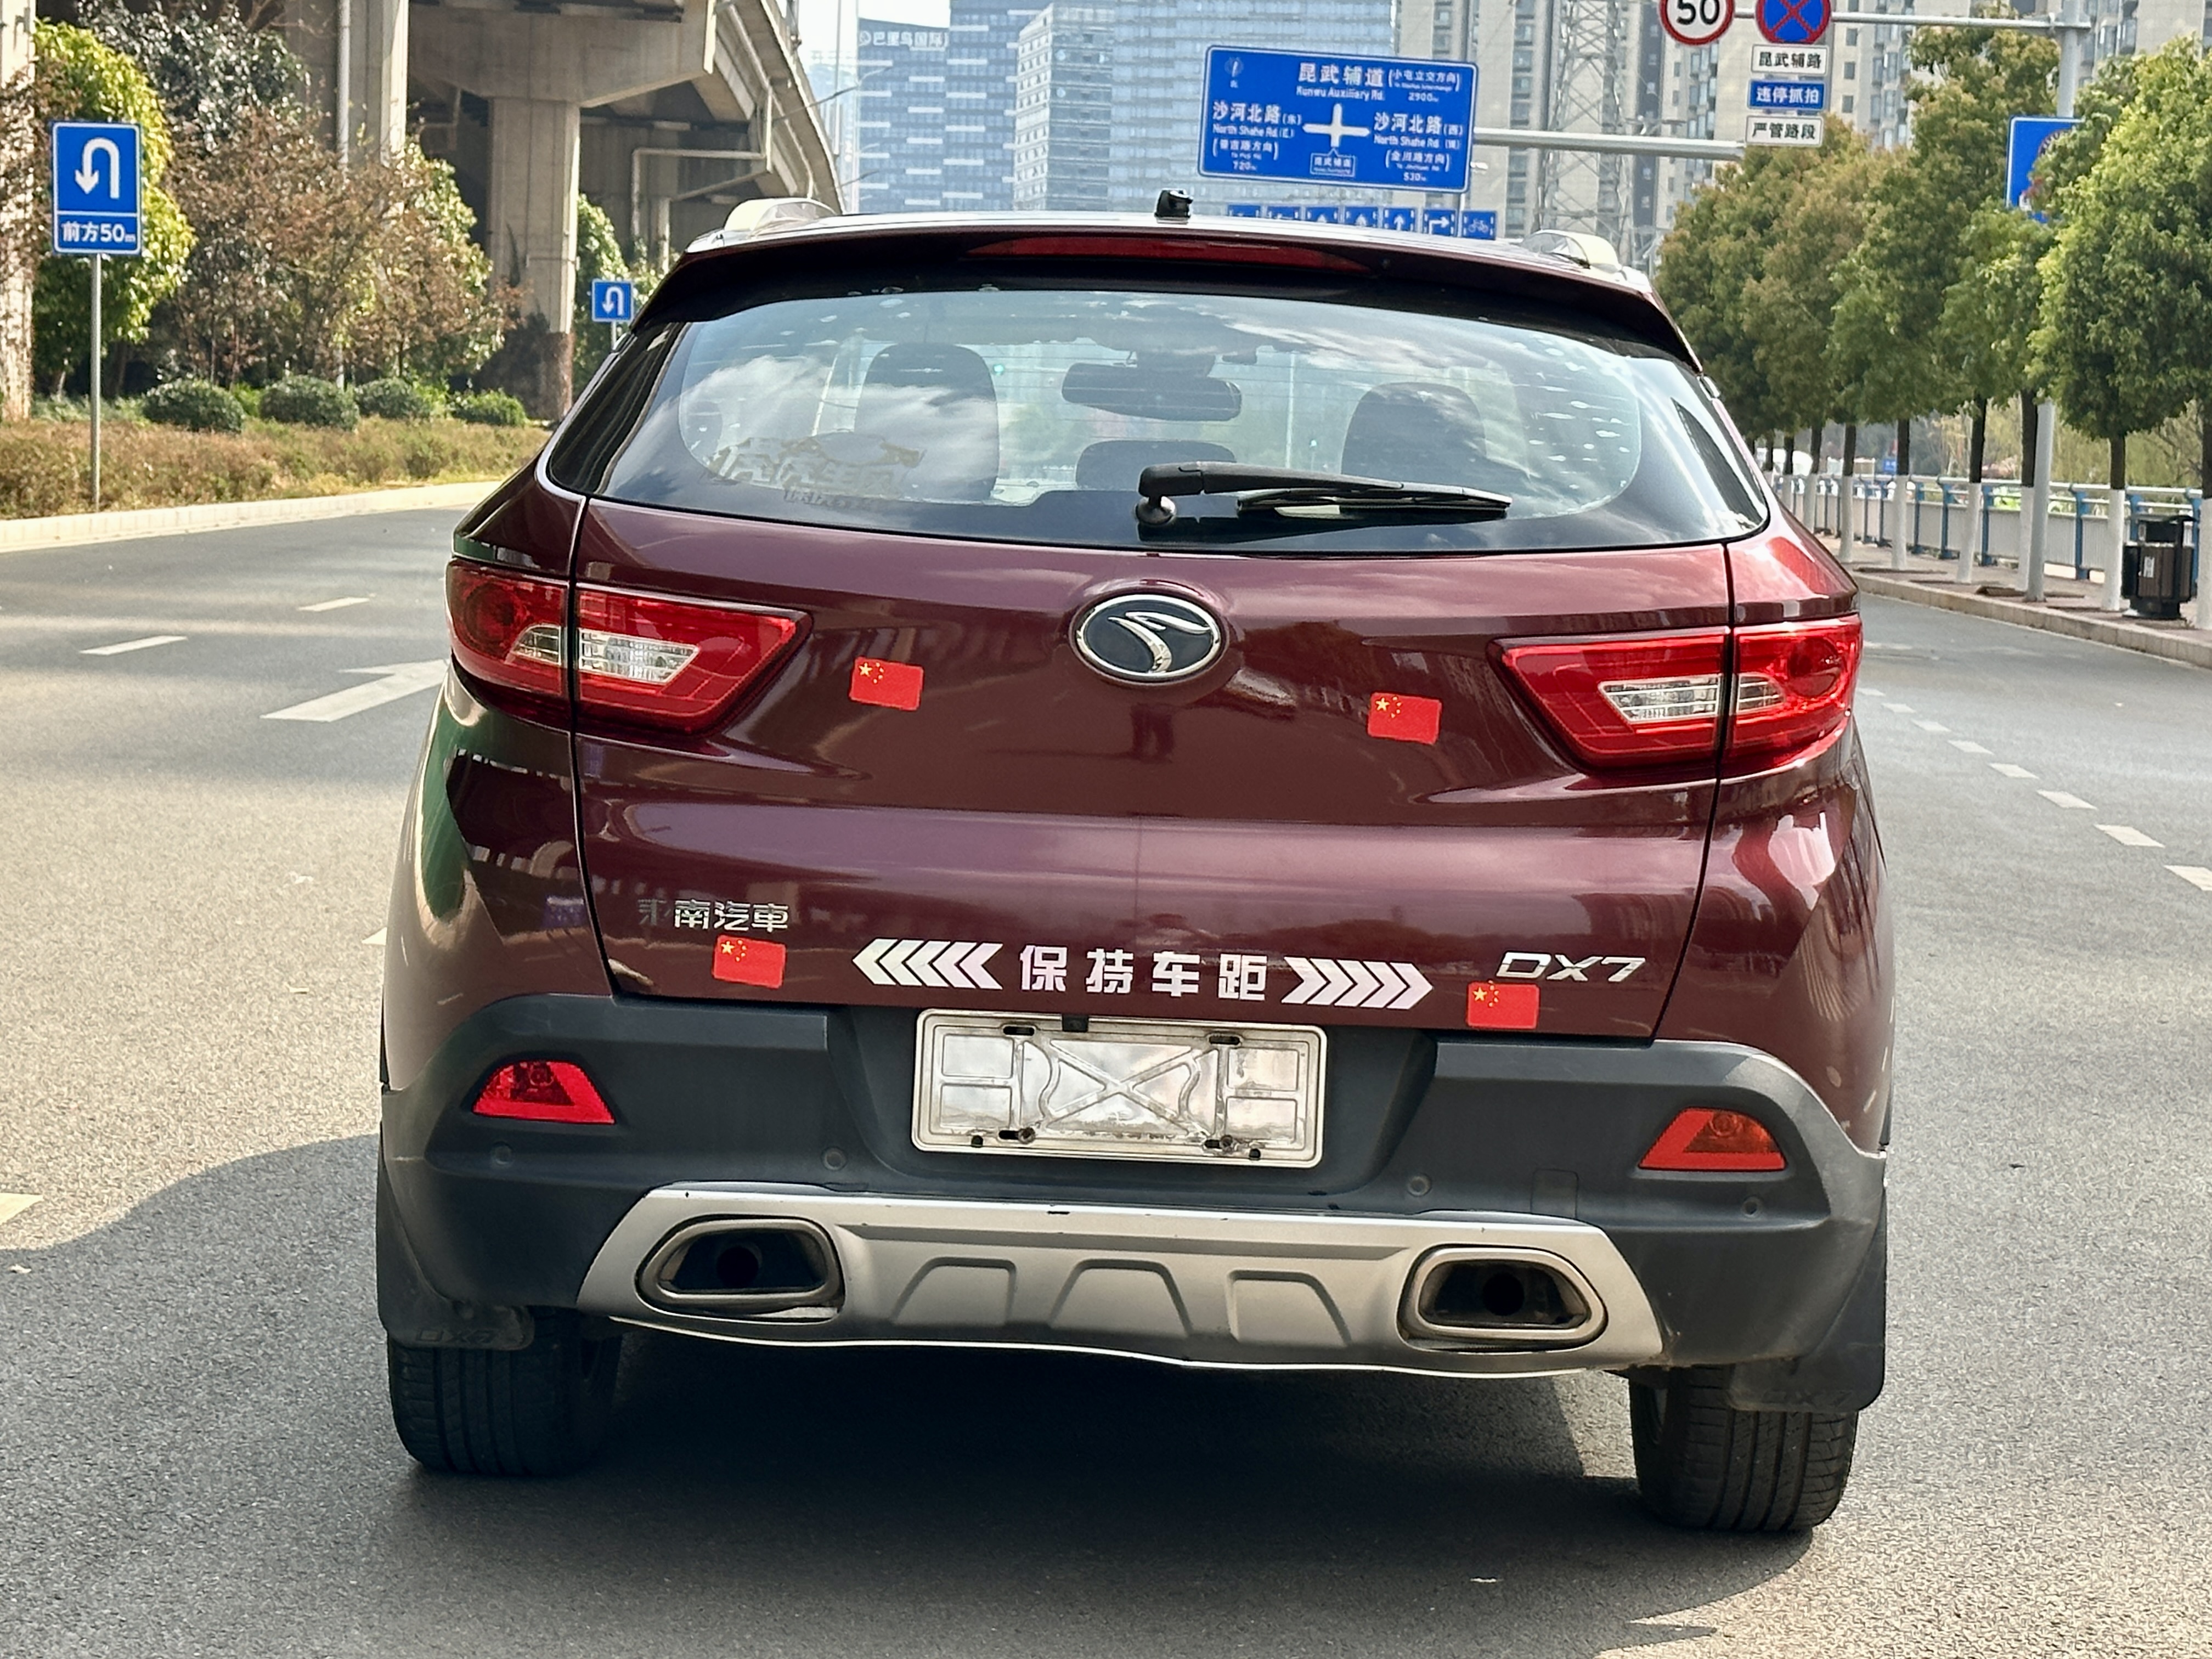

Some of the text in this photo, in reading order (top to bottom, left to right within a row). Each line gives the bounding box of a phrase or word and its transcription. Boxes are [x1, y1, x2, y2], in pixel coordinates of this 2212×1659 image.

[1675, 0, 1720, 25] 50
[1759, 52, 1821, 69] 昆武辅路
[1299, 62, 1384, 87] 昆武辅道
[1296, 86, 1327, 98] Kunwu
[1328, 86, 1369, 101] Auxiliary
[1756, 86, 1819, 104] 违停抓拍
[1752, 122, 1816, 139] 严管路段
[1373, 134, 1399, 145] North
[1400, 136, 1426, 148] Shahe
[61, 221, 136, 242] 前方50m
[1020, 945, 1267, 1001] 保持车距
[1496, 952, 1645, 982] DX7
